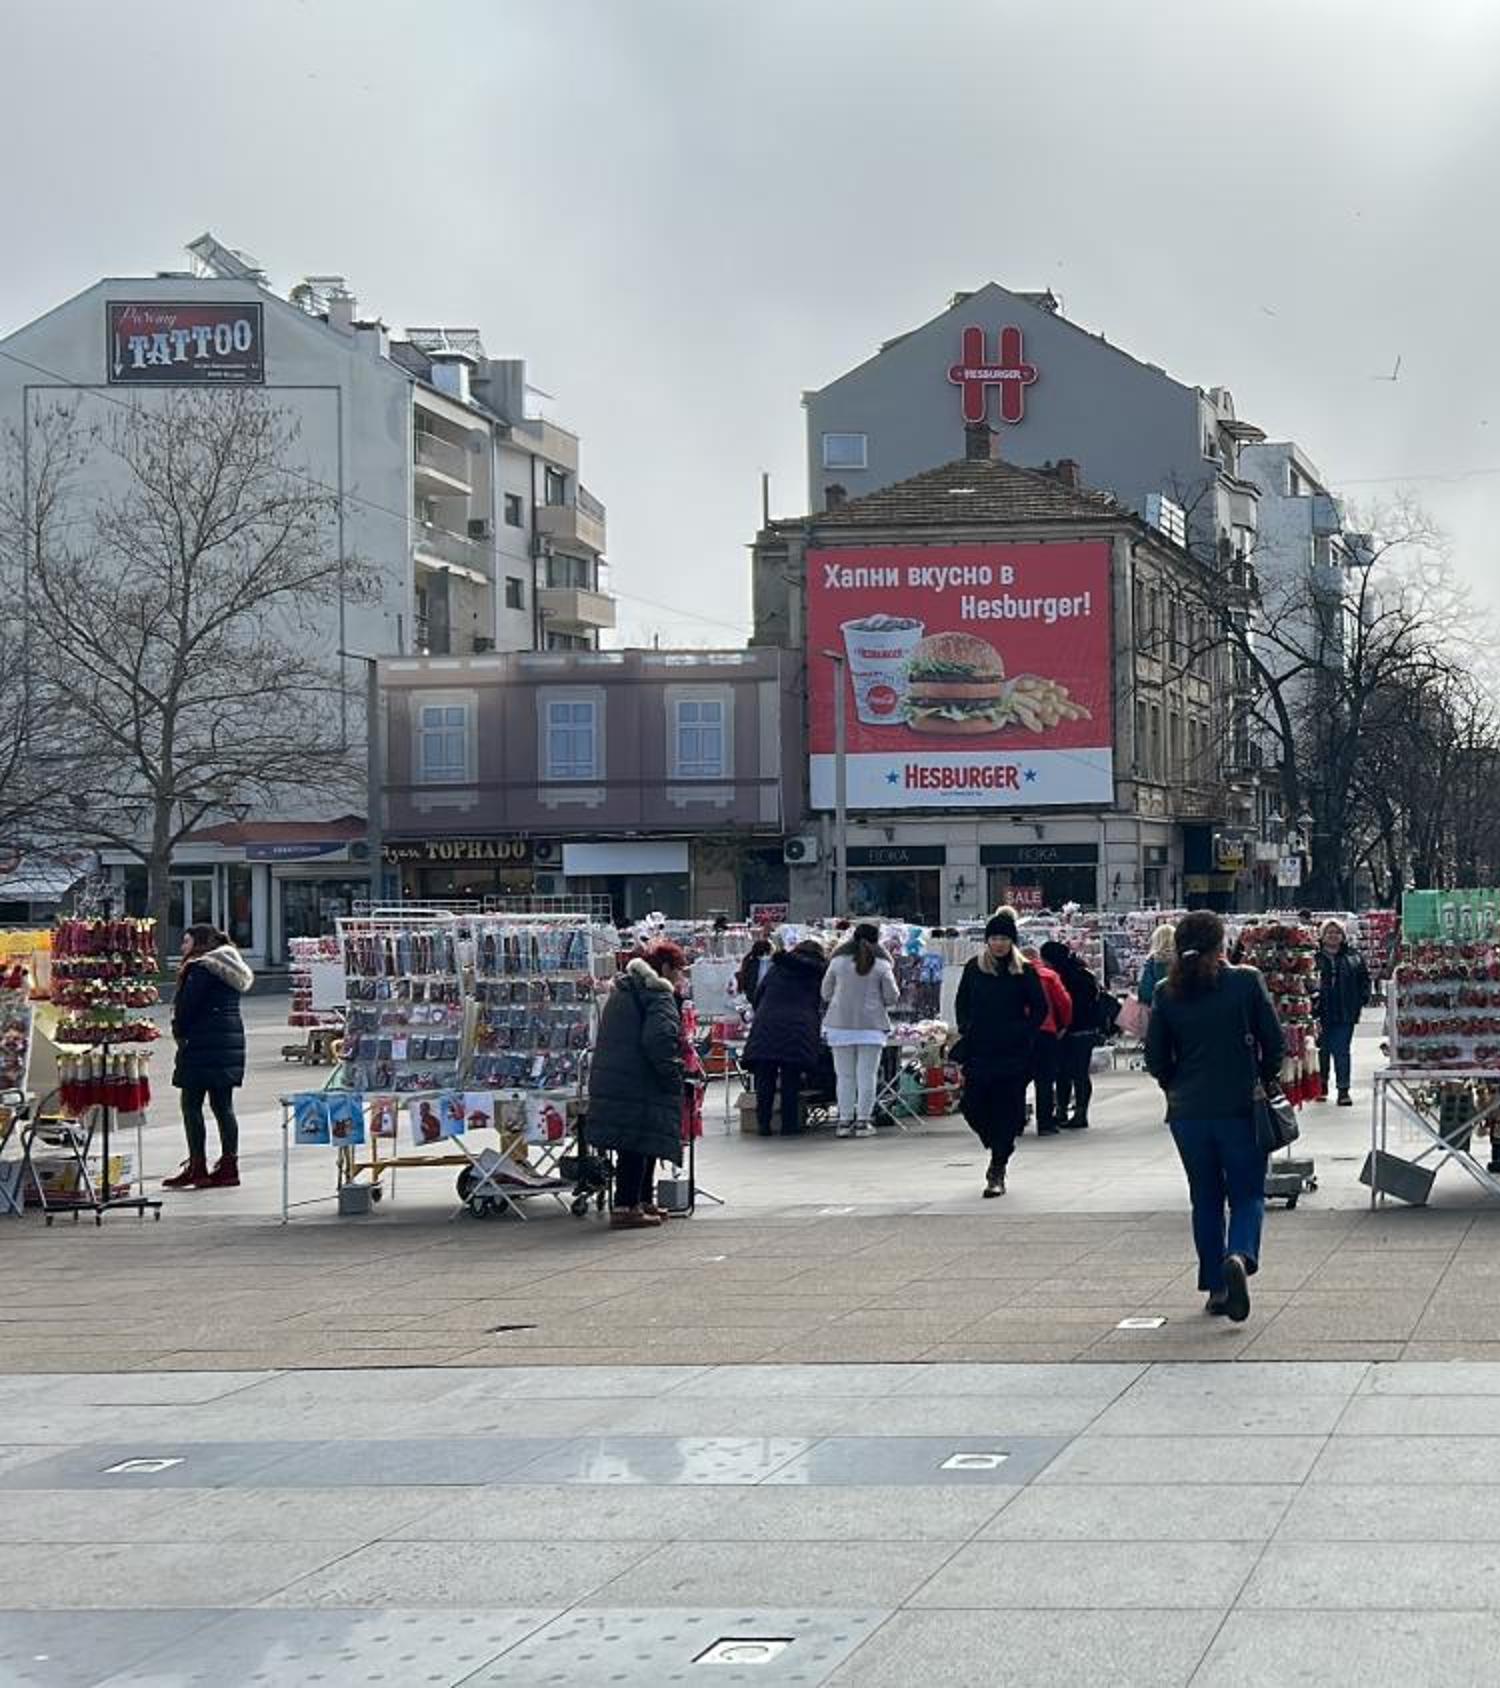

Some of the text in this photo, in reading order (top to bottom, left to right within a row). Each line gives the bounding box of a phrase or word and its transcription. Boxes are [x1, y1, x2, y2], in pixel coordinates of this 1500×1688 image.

[128, 319, 252, 369] TATTOO
[964, 368, 1021, 380] HESBURGER
[824, 564, 1014, 592] Хапни вкусно в
[961, 591, 1091, 624] Hesburger!
[905, 764, 1020, 790] HESBURGER
[1005, 891, 1041, 905] SALE
